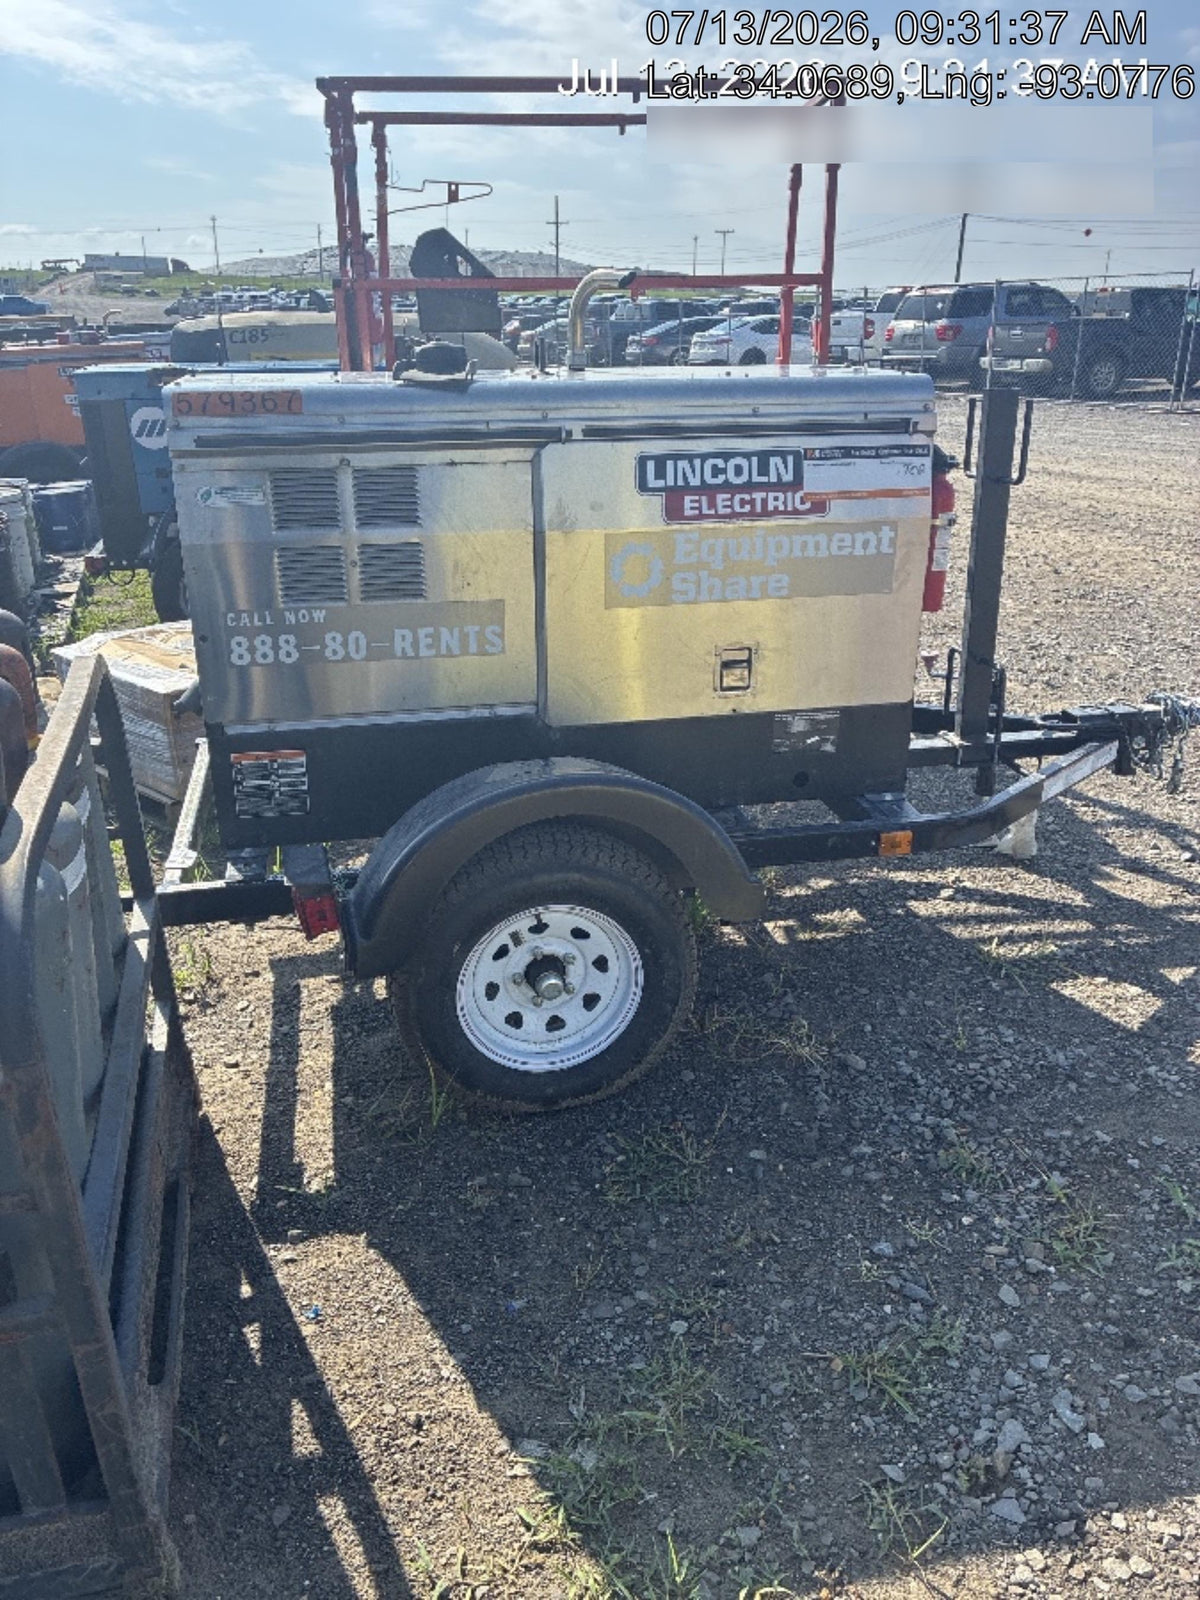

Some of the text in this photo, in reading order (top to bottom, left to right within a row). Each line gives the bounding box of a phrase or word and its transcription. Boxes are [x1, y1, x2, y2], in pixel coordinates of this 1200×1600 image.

[228, 327, 272, 345] C185
[176, 390, 299, 416] 579367
[646, 454, 795, 488] LINCOLN
[683, 490, 812, 517] ELECTRIC
[672, 525, 895, 570] Equipment
[671, 570, 791, 604] Share
[226, 608, 327, 627] CALL NOW
[229, 624, 505, 666] 888-80-RENTS
